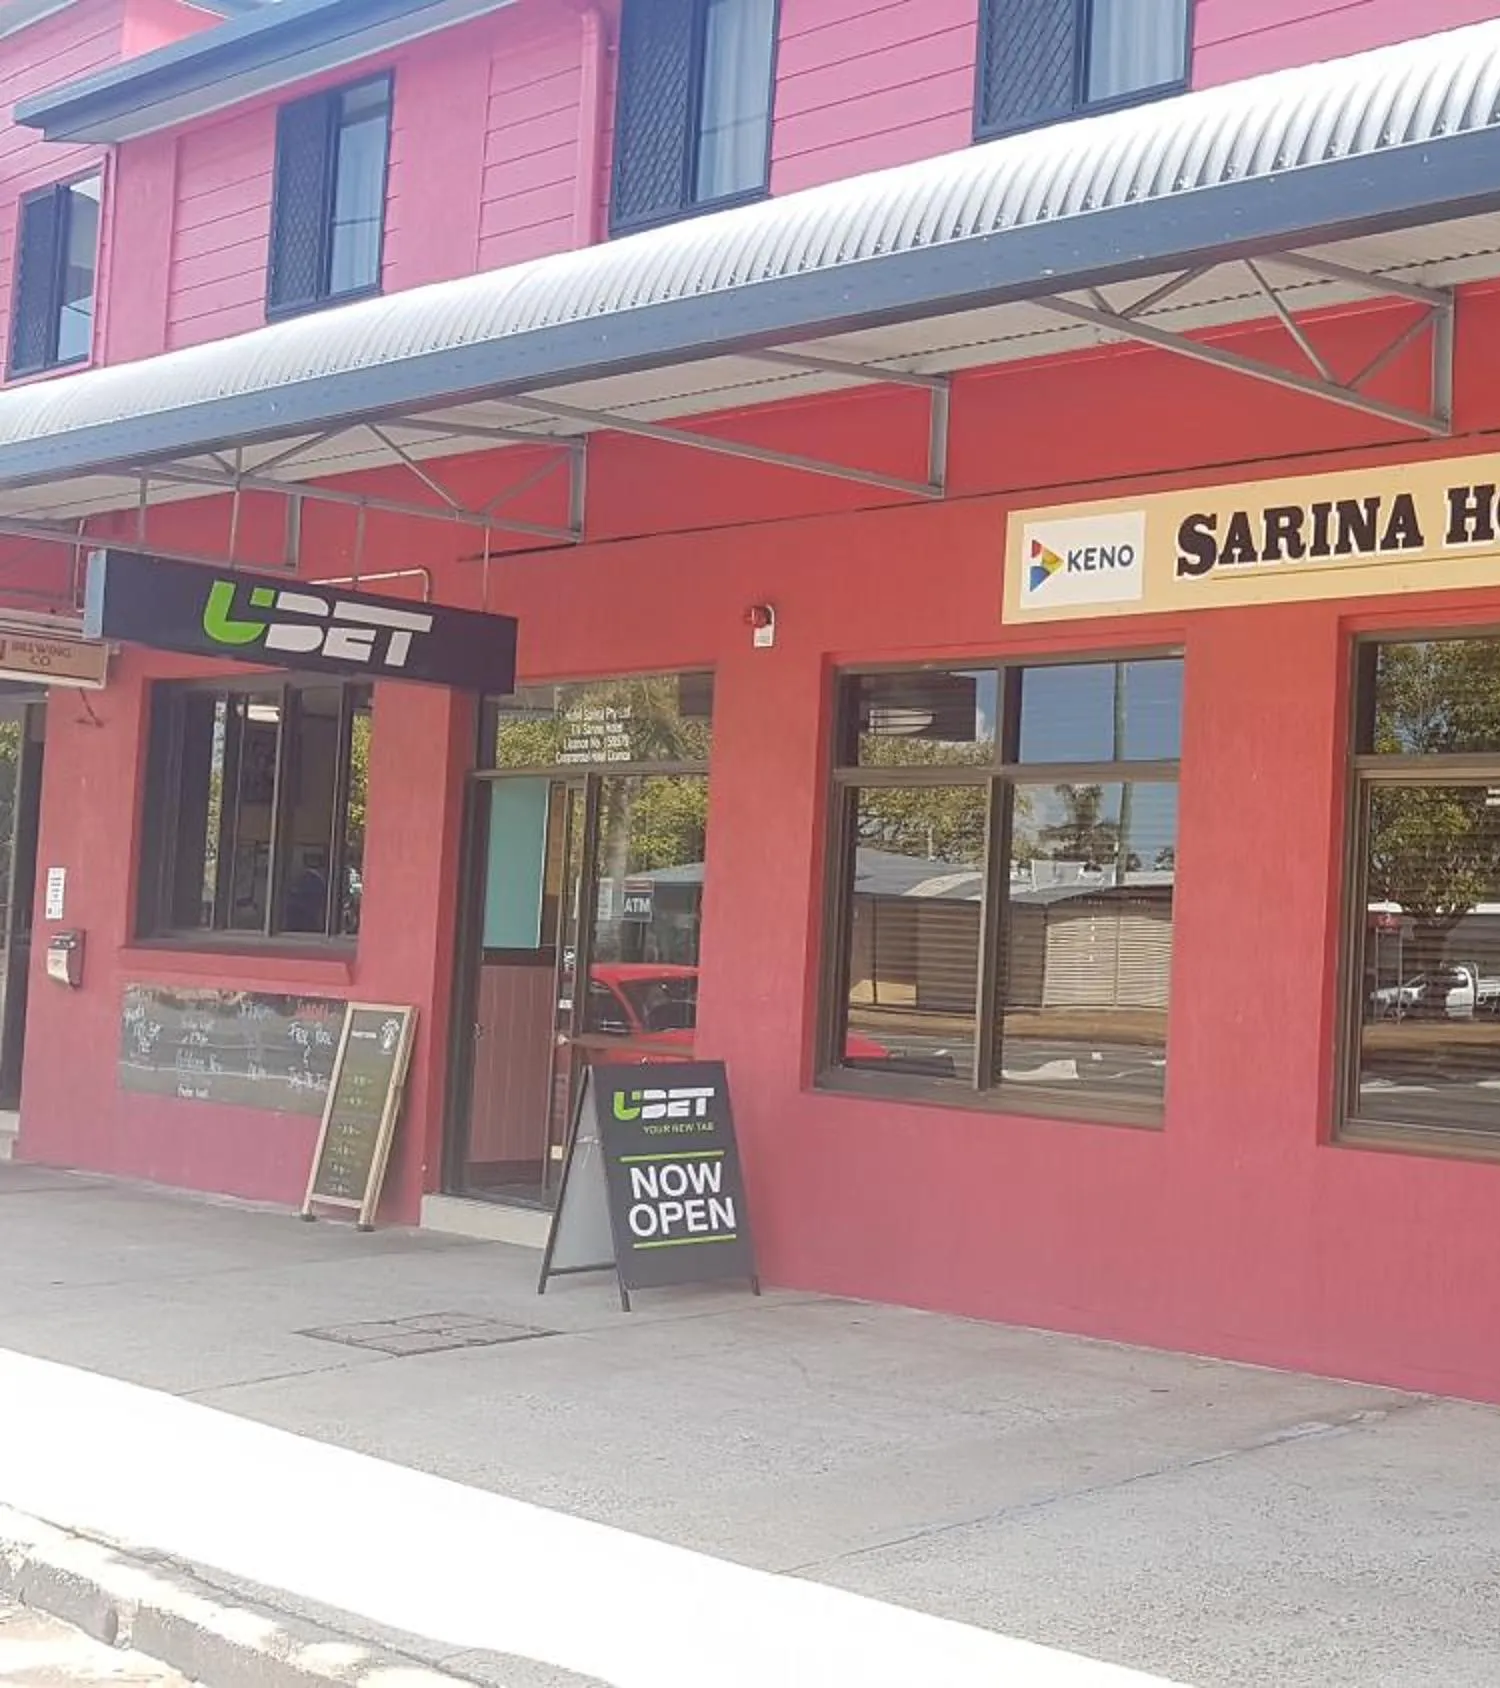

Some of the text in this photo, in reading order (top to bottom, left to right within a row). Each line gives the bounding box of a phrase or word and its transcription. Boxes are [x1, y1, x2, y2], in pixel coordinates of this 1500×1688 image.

[1175, 493, 1424, 577] SARINA
[1067, 545, 1134, 573] KENO
[203, 579, 433, 666] UBET
[624, 897, 651, 913] ATM
[613, 1087, 715, 1121] UBET
[643, 1121, 715, 1135] YOUR NEW TAB
[629, 1161, 722, 1199] NOW
[628, 1197, 737, 1237] OPEN
